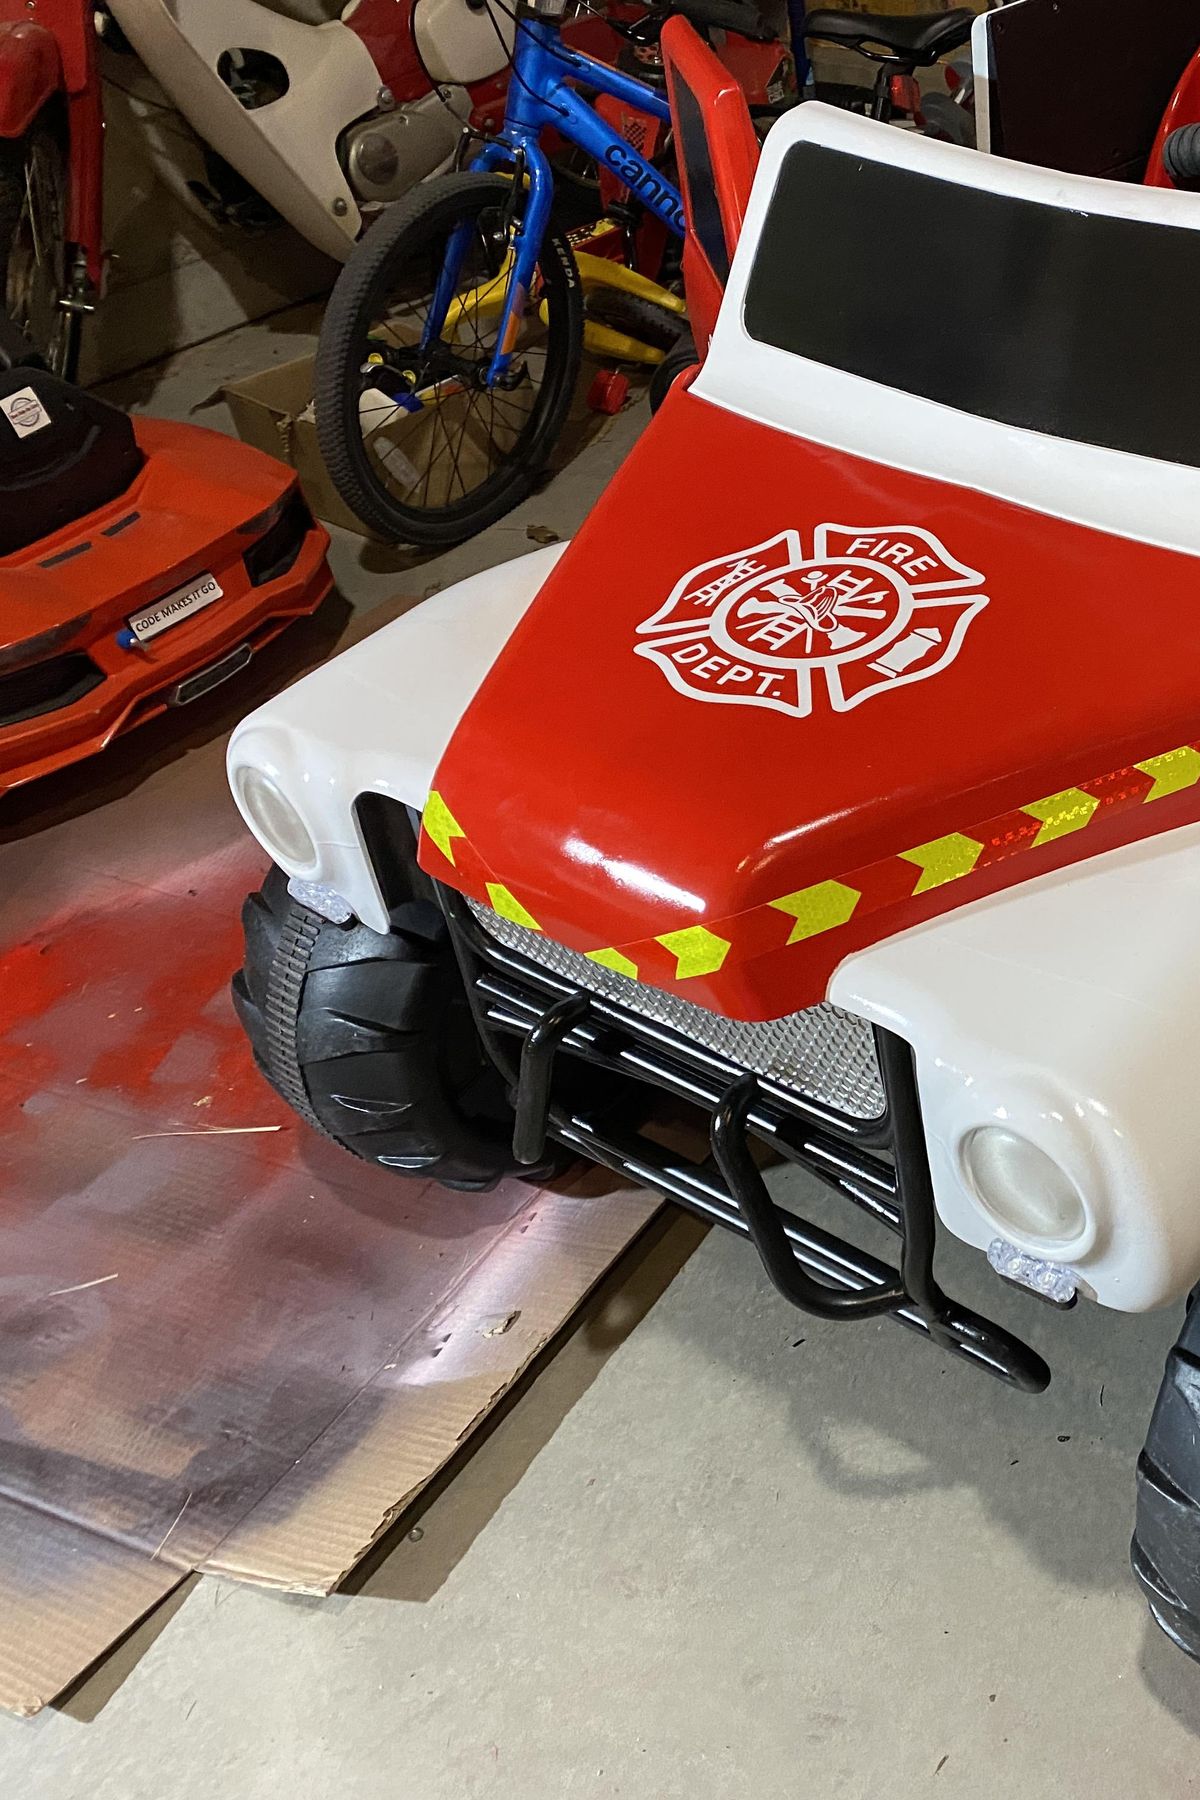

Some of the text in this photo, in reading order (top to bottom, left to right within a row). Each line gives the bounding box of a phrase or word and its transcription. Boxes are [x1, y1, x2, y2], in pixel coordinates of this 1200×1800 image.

[552, 238, 575, 288] KENDA
[846, 537, 939, 577] FIRE
[135, 581, 216, 632] CODE MAKES IT GO
[671, 642, 785, 698] DEPT.
